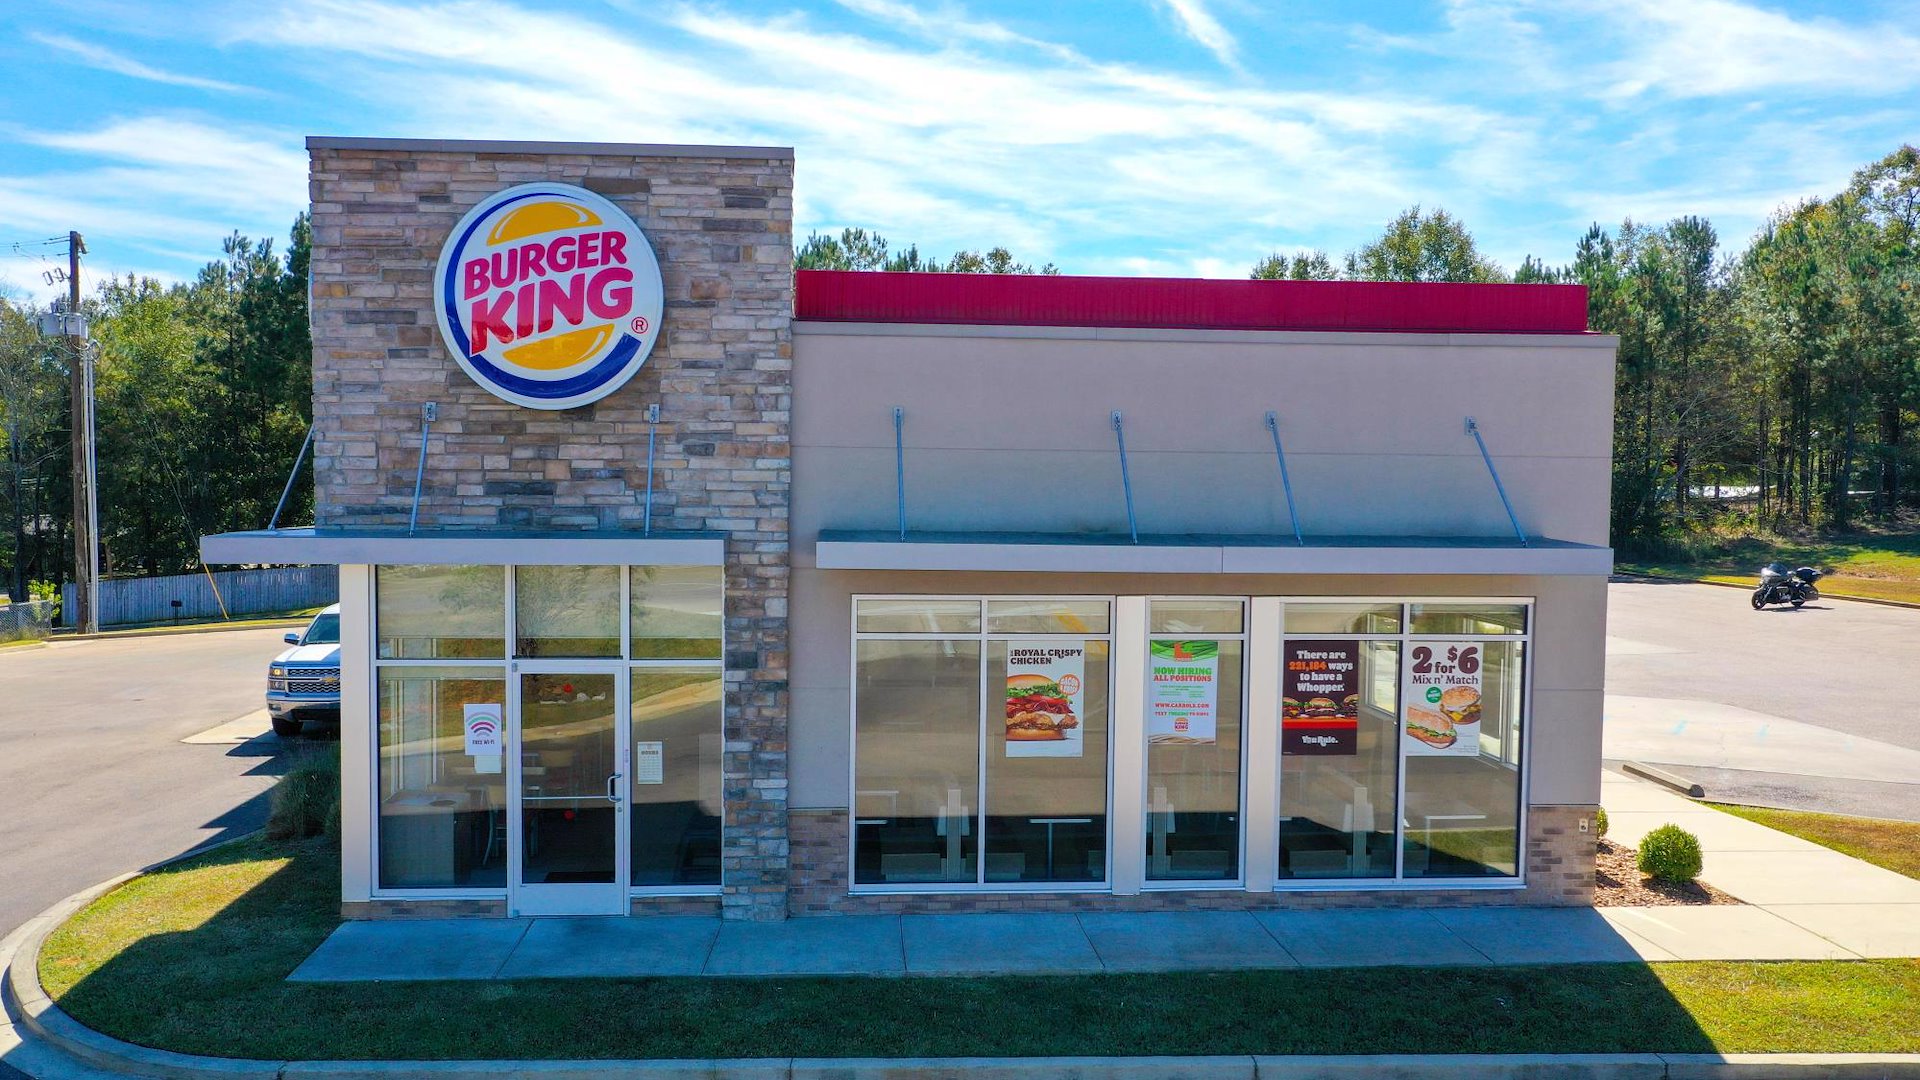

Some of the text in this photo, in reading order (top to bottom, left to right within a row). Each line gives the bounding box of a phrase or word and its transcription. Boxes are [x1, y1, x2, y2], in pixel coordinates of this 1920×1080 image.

[464, 231, 627, 300] BURGER
[471, 267, 633, 355] KING
[1014, 649, 1046, 657] ROYAL
[1047, 649, 1082, 659] CRISPY
[1296, 650, 1347, 659] There are
[1010, 657, 1052, 665] CHICKEN
[1412, 645, 1479, 674] 2 for $6
[1154, 667, 1212, 675] NOW HIRING
[1289, 661, 1353, 672] 221,184 ways
[1300, 671, 1343, 681] to have a
[1412, 675, 1479, 685] Mix n' Match
